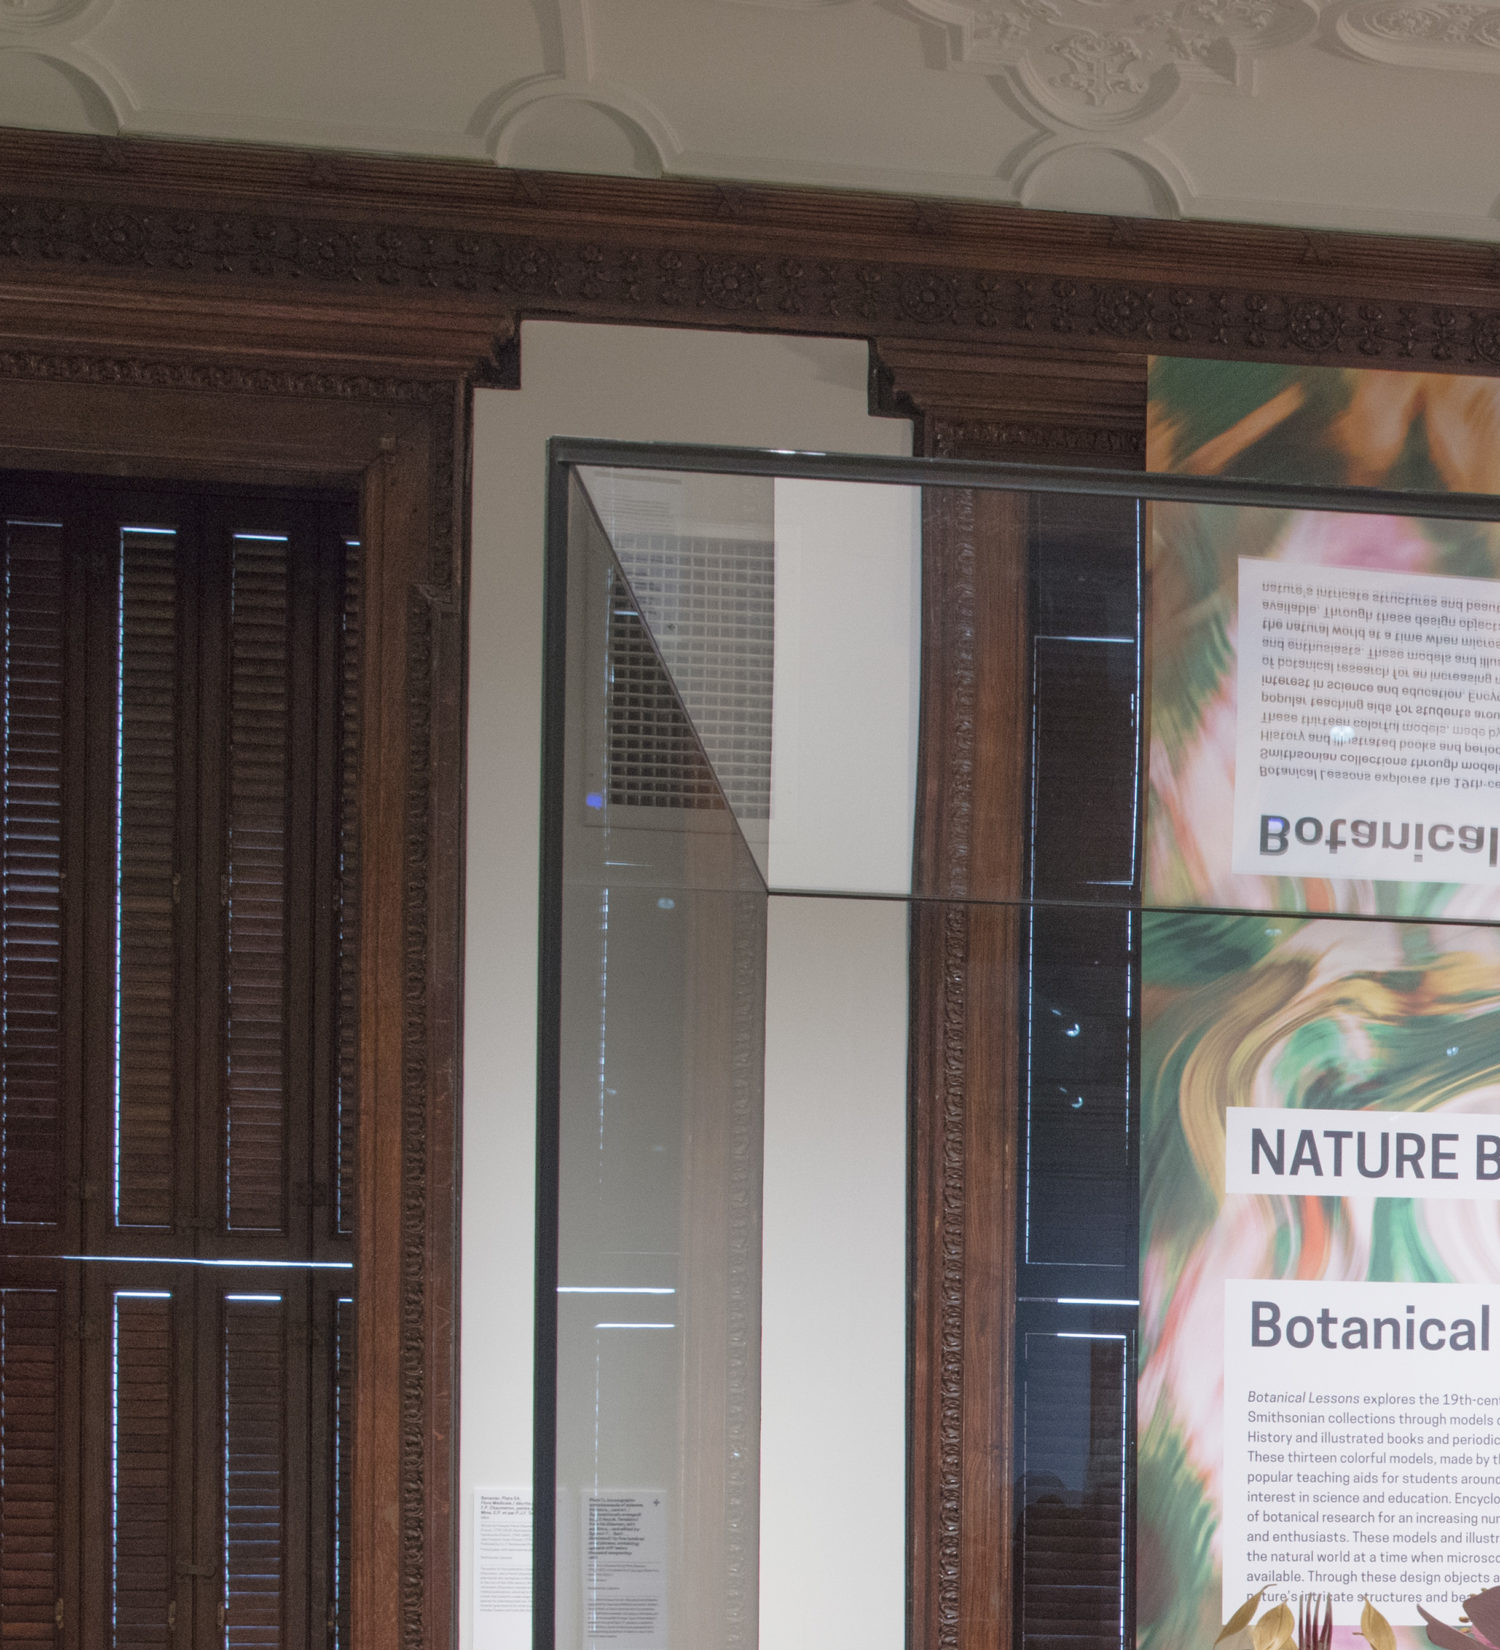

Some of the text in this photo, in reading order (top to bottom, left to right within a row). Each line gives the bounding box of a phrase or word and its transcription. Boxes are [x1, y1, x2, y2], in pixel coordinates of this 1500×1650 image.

[1251, 1127, 1459, 1180] NATURE
[1251, 1300, 1490, 1352] Botanical
[1247, 1390, 1307, 1404] Botanical
[1308, 1391, 1360, 1405] Lessons
[1363, 1392, 1416, 1407] explores
[1418, 1392, 1440, 1406] the
[1247, 1410, 1326, 1424] Smithsonian
[1327, 1411, 1396, 1425] collections
[1398, 1412, 1447, 1428] through
[1449, 1413, 1494, 1426] models
[1247, 1430, 1293, 1446] History
[1295, 1431, 1318, 1444] and
[1320, 1431, 1384, 1445] illustrated
[1387, 1432, 1424, 1445] books
[1426, 1433, 1450, 1445] and
[1247, 1450, 1285, 1463] These
[1287, 1450, 1337, 1464] thirteen
[1339, 1451, 1387, 1464] colorful
[1389, 1452, 1437, 1465] models,
[1439, 1452, 1473, 1465] made
[1475, 1452, 1490, 1468] by
